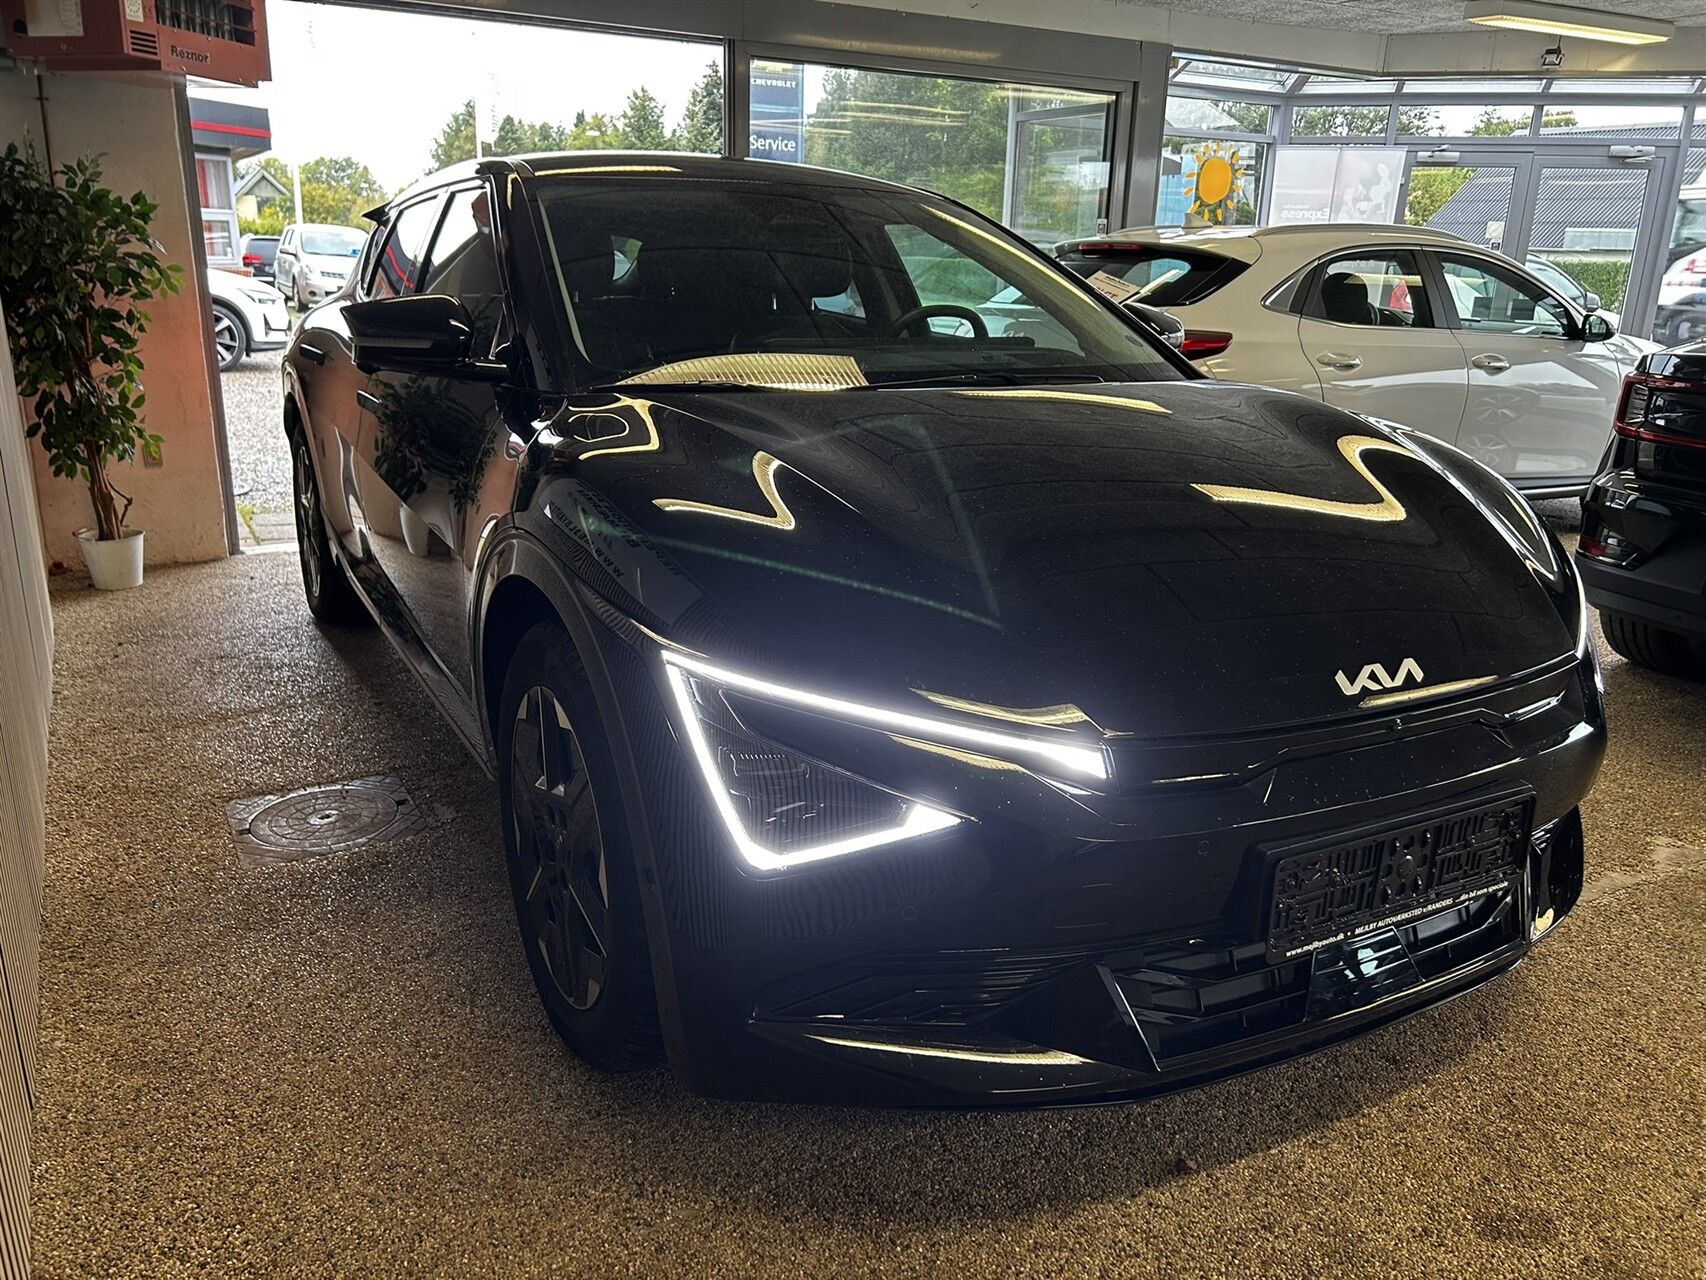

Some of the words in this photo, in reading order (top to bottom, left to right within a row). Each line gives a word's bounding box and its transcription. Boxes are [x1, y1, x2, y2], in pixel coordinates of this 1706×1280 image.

[170, 45, 209, 63] Reznor
[750, 78, 796, 88] CHEVROLET
[749, 135, 796, 152] Service
[1334, 658, 1424, 695] KIA
